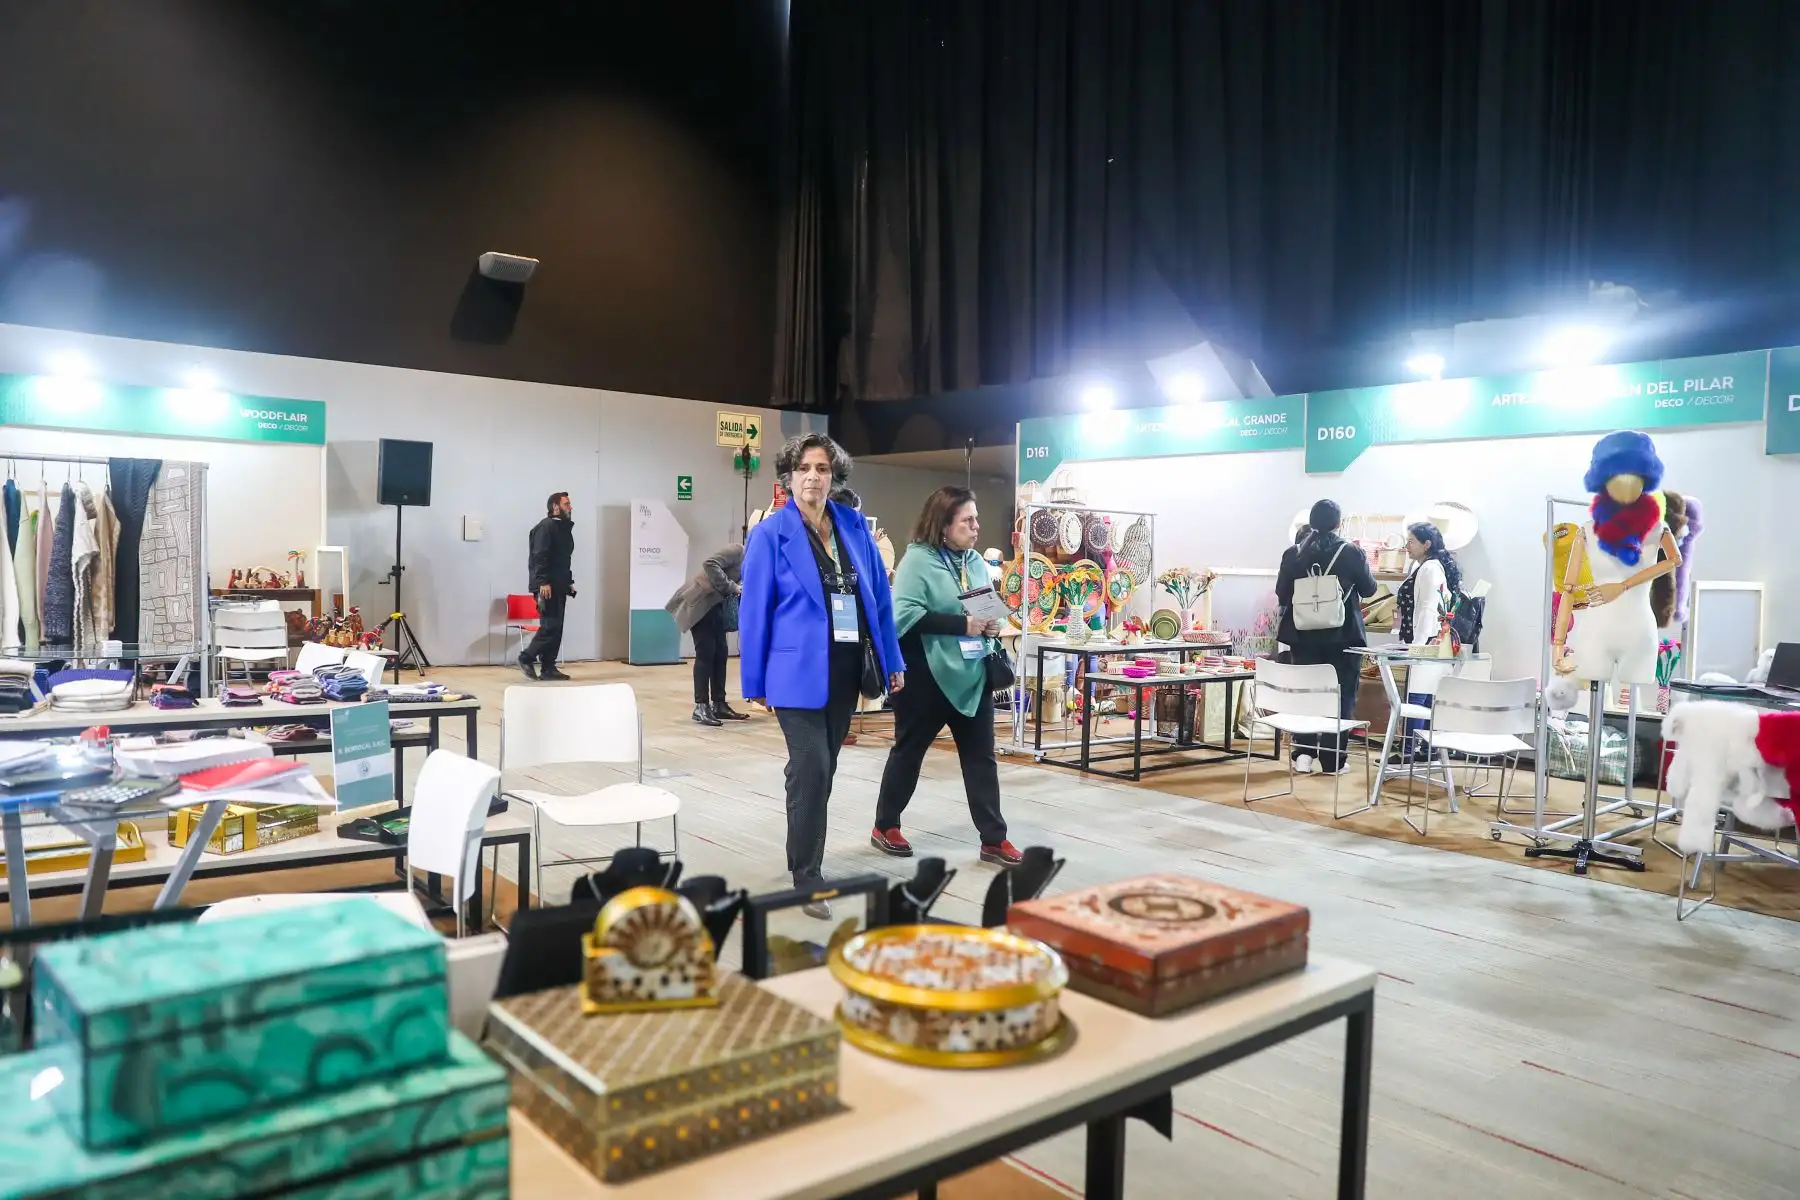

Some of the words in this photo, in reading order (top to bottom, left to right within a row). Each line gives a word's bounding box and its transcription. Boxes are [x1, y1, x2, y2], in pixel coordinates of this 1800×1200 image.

[1646, 381, 1679, 395] DEL
[1683, 376, 1734, 393] PILAR
[1654, 398, 1684, 408] DECO
[1694, 394, 1734, 406] DECOR
[240, 408, 308, 422] WOODFLAIR
[1243, 412, 1288, 426] GRANDE
[257, 421, 278, 430] DECO
[720, 420, 743, 432] SALIDA
[1317, 425, 1356, 441] D160
[1026, 446, 1049, 459] D161
